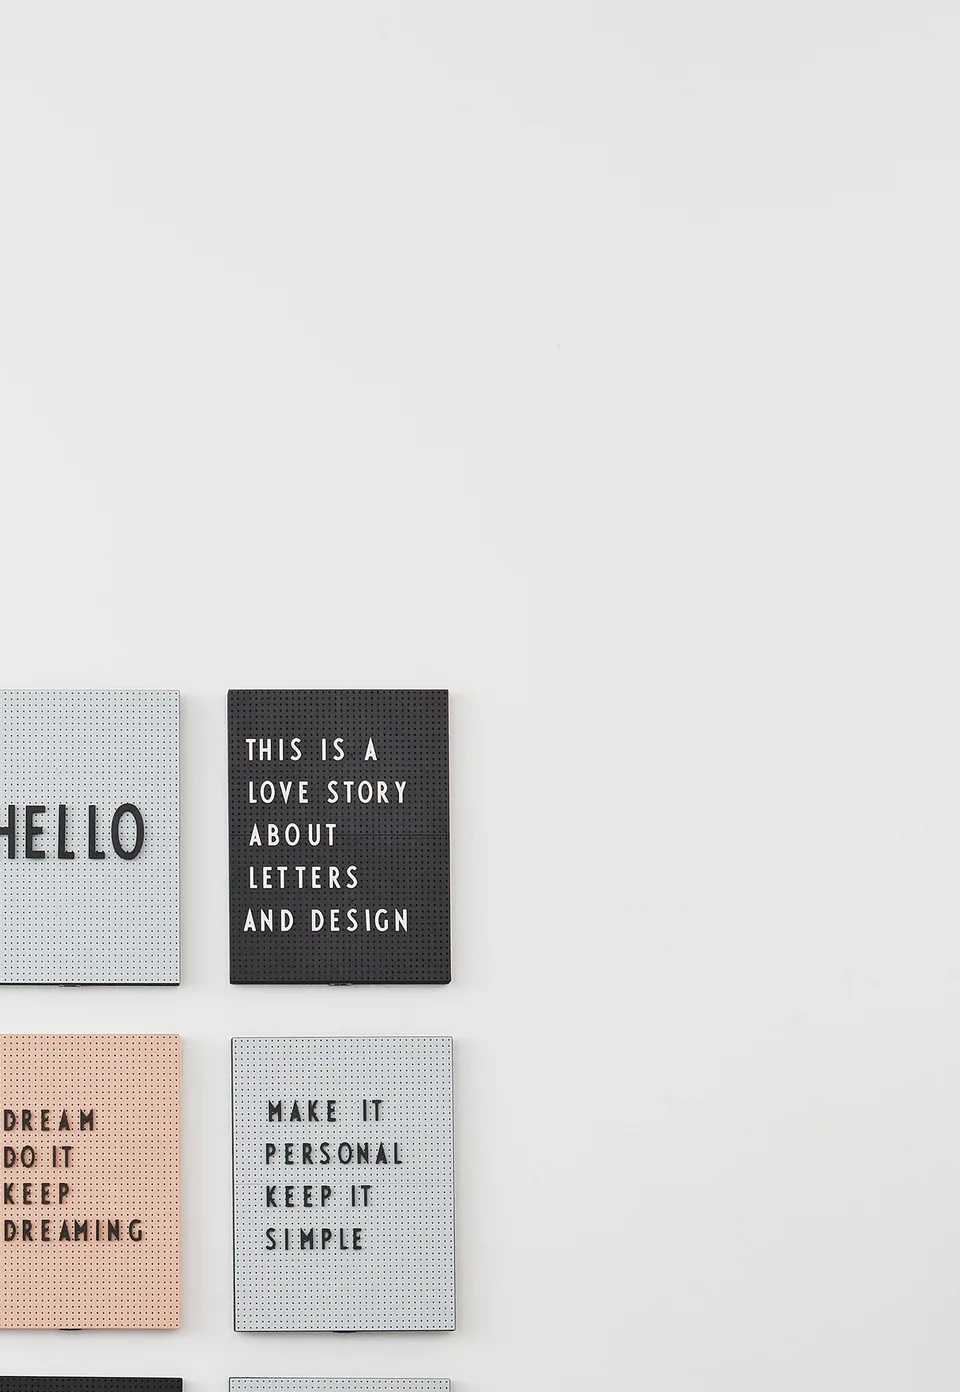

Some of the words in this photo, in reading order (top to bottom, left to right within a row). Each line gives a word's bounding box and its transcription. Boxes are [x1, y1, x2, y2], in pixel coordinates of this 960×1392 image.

[245, 737, 302, 761] THIS
[321, 737, 345, 761] IS
[364, 736, 378, 761] A
[248, 780, 309, 804] LOVE
[326, 779, 407, 804] STORY
[248, 822, 337, 847] ABOUT
[249, 865, 358, 889] LETTERS
[243, 907, 294, 932] AND
[311, 908, 408, 933] DESIGN
[3, 1108, 94, 1132] DREAM
[268, 1099, 337, 1123] MAKE
[362, 1098, 382, 1122] IT
[3, 1145, 36, 1169] DO
[52, 1145, 74, 1168] IT
[265, 1141, 403, 1165] PERSONAL
[3, 1182, 70, 1205] KEEP
[266, 1185, 332, 1208] KEEP
[351, 1184, 373, 1208] IT
[4, 1218, 143, 1242] DREAMING
[265, 1227, 362, 1251] SIMPLE
